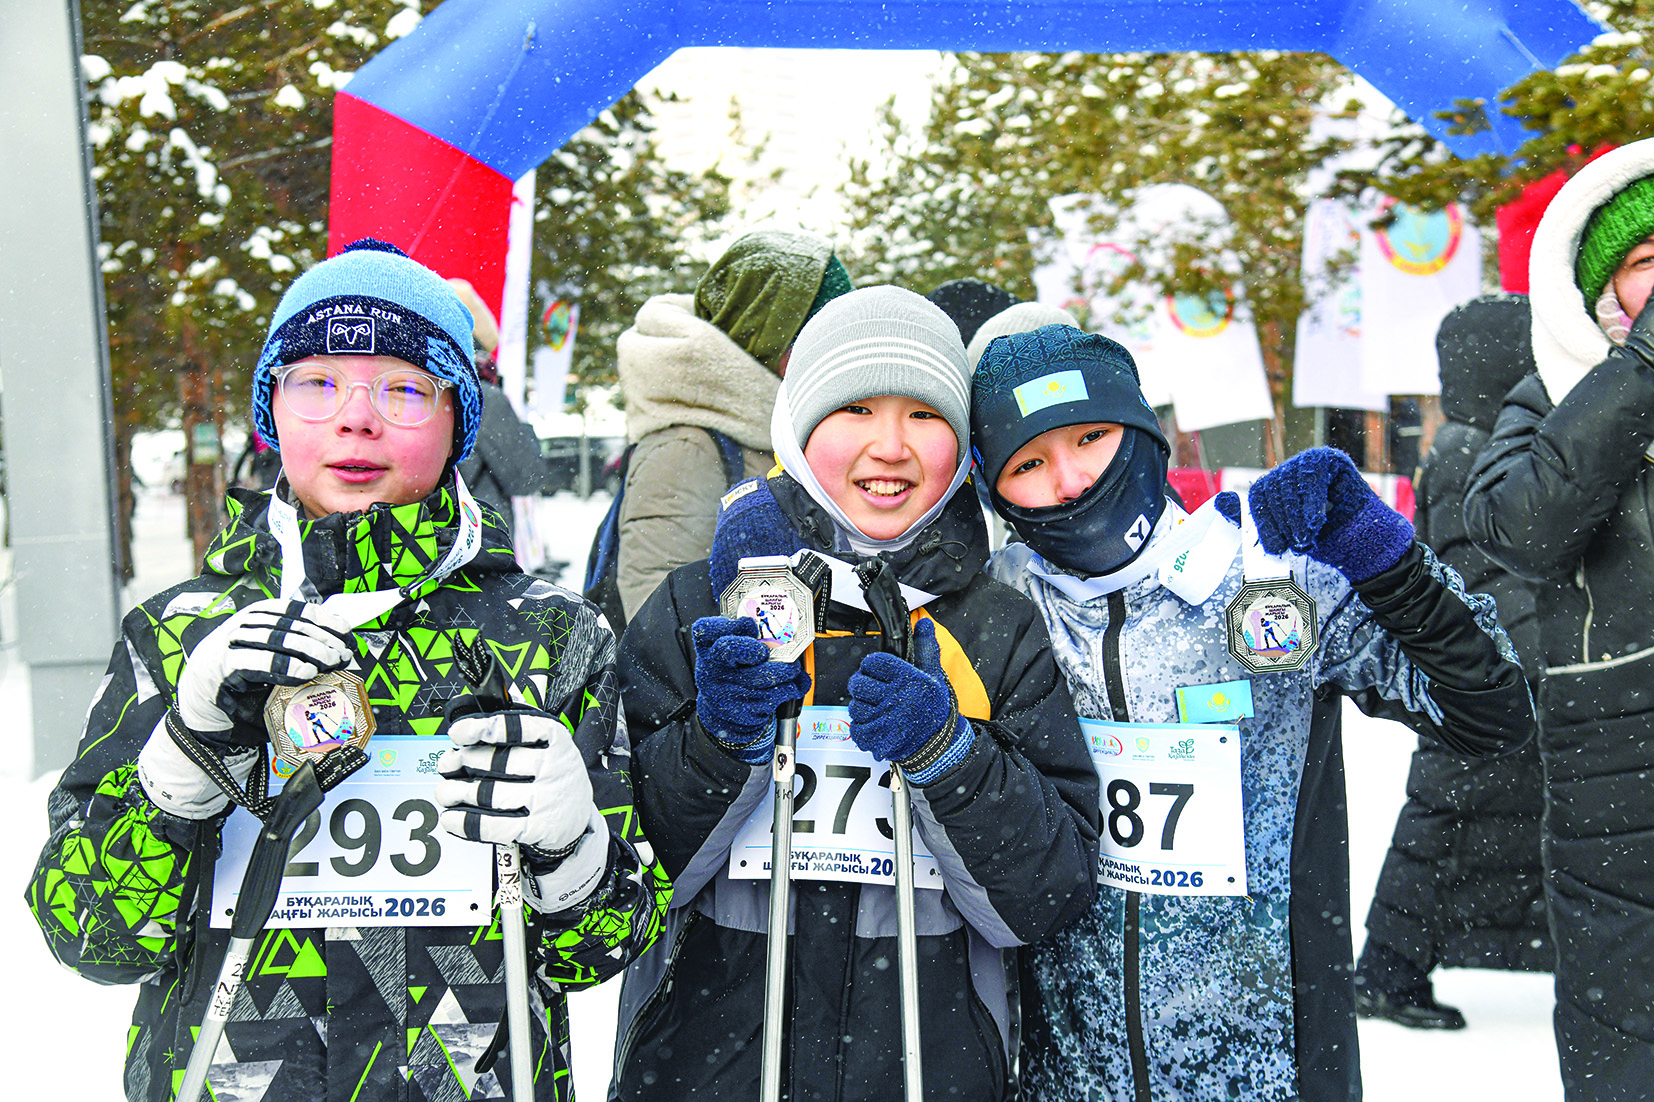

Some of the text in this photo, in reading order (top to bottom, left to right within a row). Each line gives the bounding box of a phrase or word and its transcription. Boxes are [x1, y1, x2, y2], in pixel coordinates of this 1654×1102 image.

[306, 304, 402, 325] ASTANA RUN
[1173, 550, 1190, 573] 026
[320, 701, 336, 710] 2026
[1099, 779, 1194, 850] 87
[283, 799, 441, 877] 293
[763, 857, 896, 876] ШҒЫ ЖАРЫСЫ 20
[1098, 857, 1141, 875] ҚАРАЛЫҚ
[1107, 869, 1149, 885] ЖАРЫСЫ
[1150, 869, 1204, 887] 2026
[271, 898, 446, 921] АҢҒЫ ЖАРЫСЫ 2026
[286, 896, 373, 908] БҰҚАРАЛЫҚ
